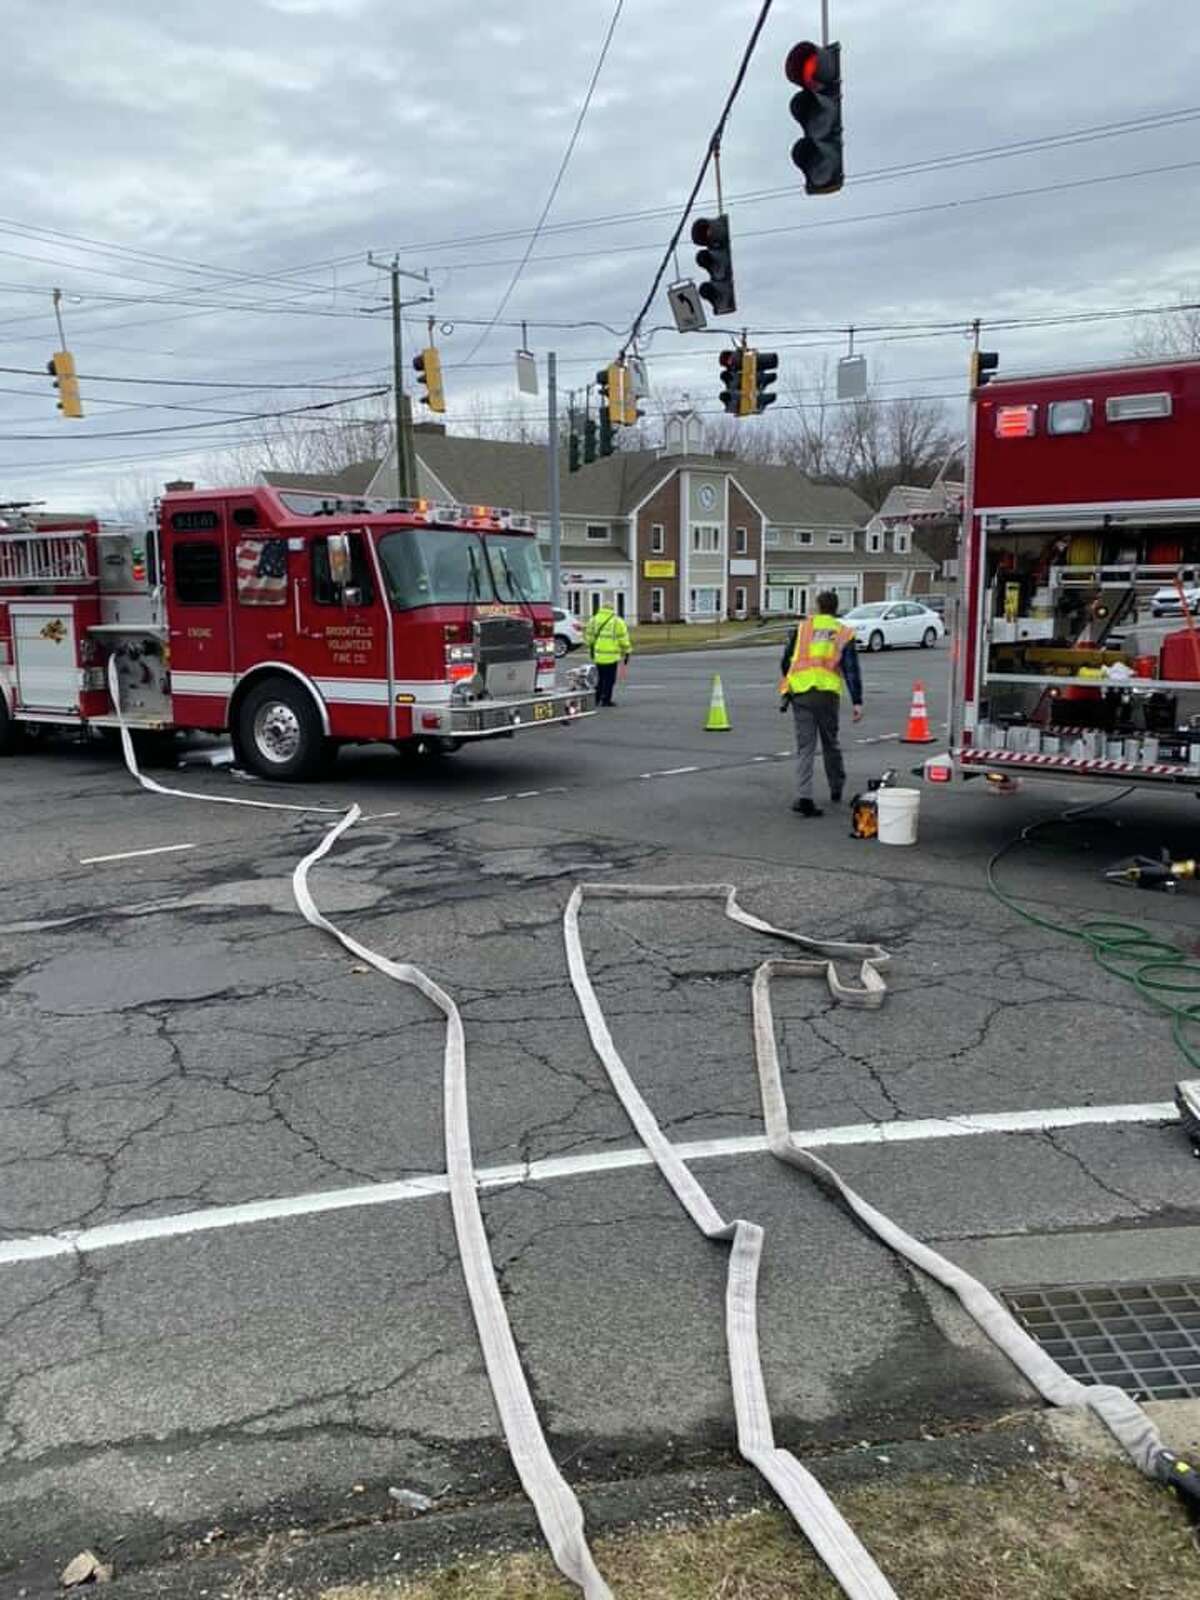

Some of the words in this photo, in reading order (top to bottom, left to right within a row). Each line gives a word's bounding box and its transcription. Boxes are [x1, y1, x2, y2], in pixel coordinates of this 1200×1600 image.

[325, 626, 374, 637] BROOKFIELD
[328, 639, 372, 650] VOLUNTEER
[333, 652, 351, 664] FIRE
